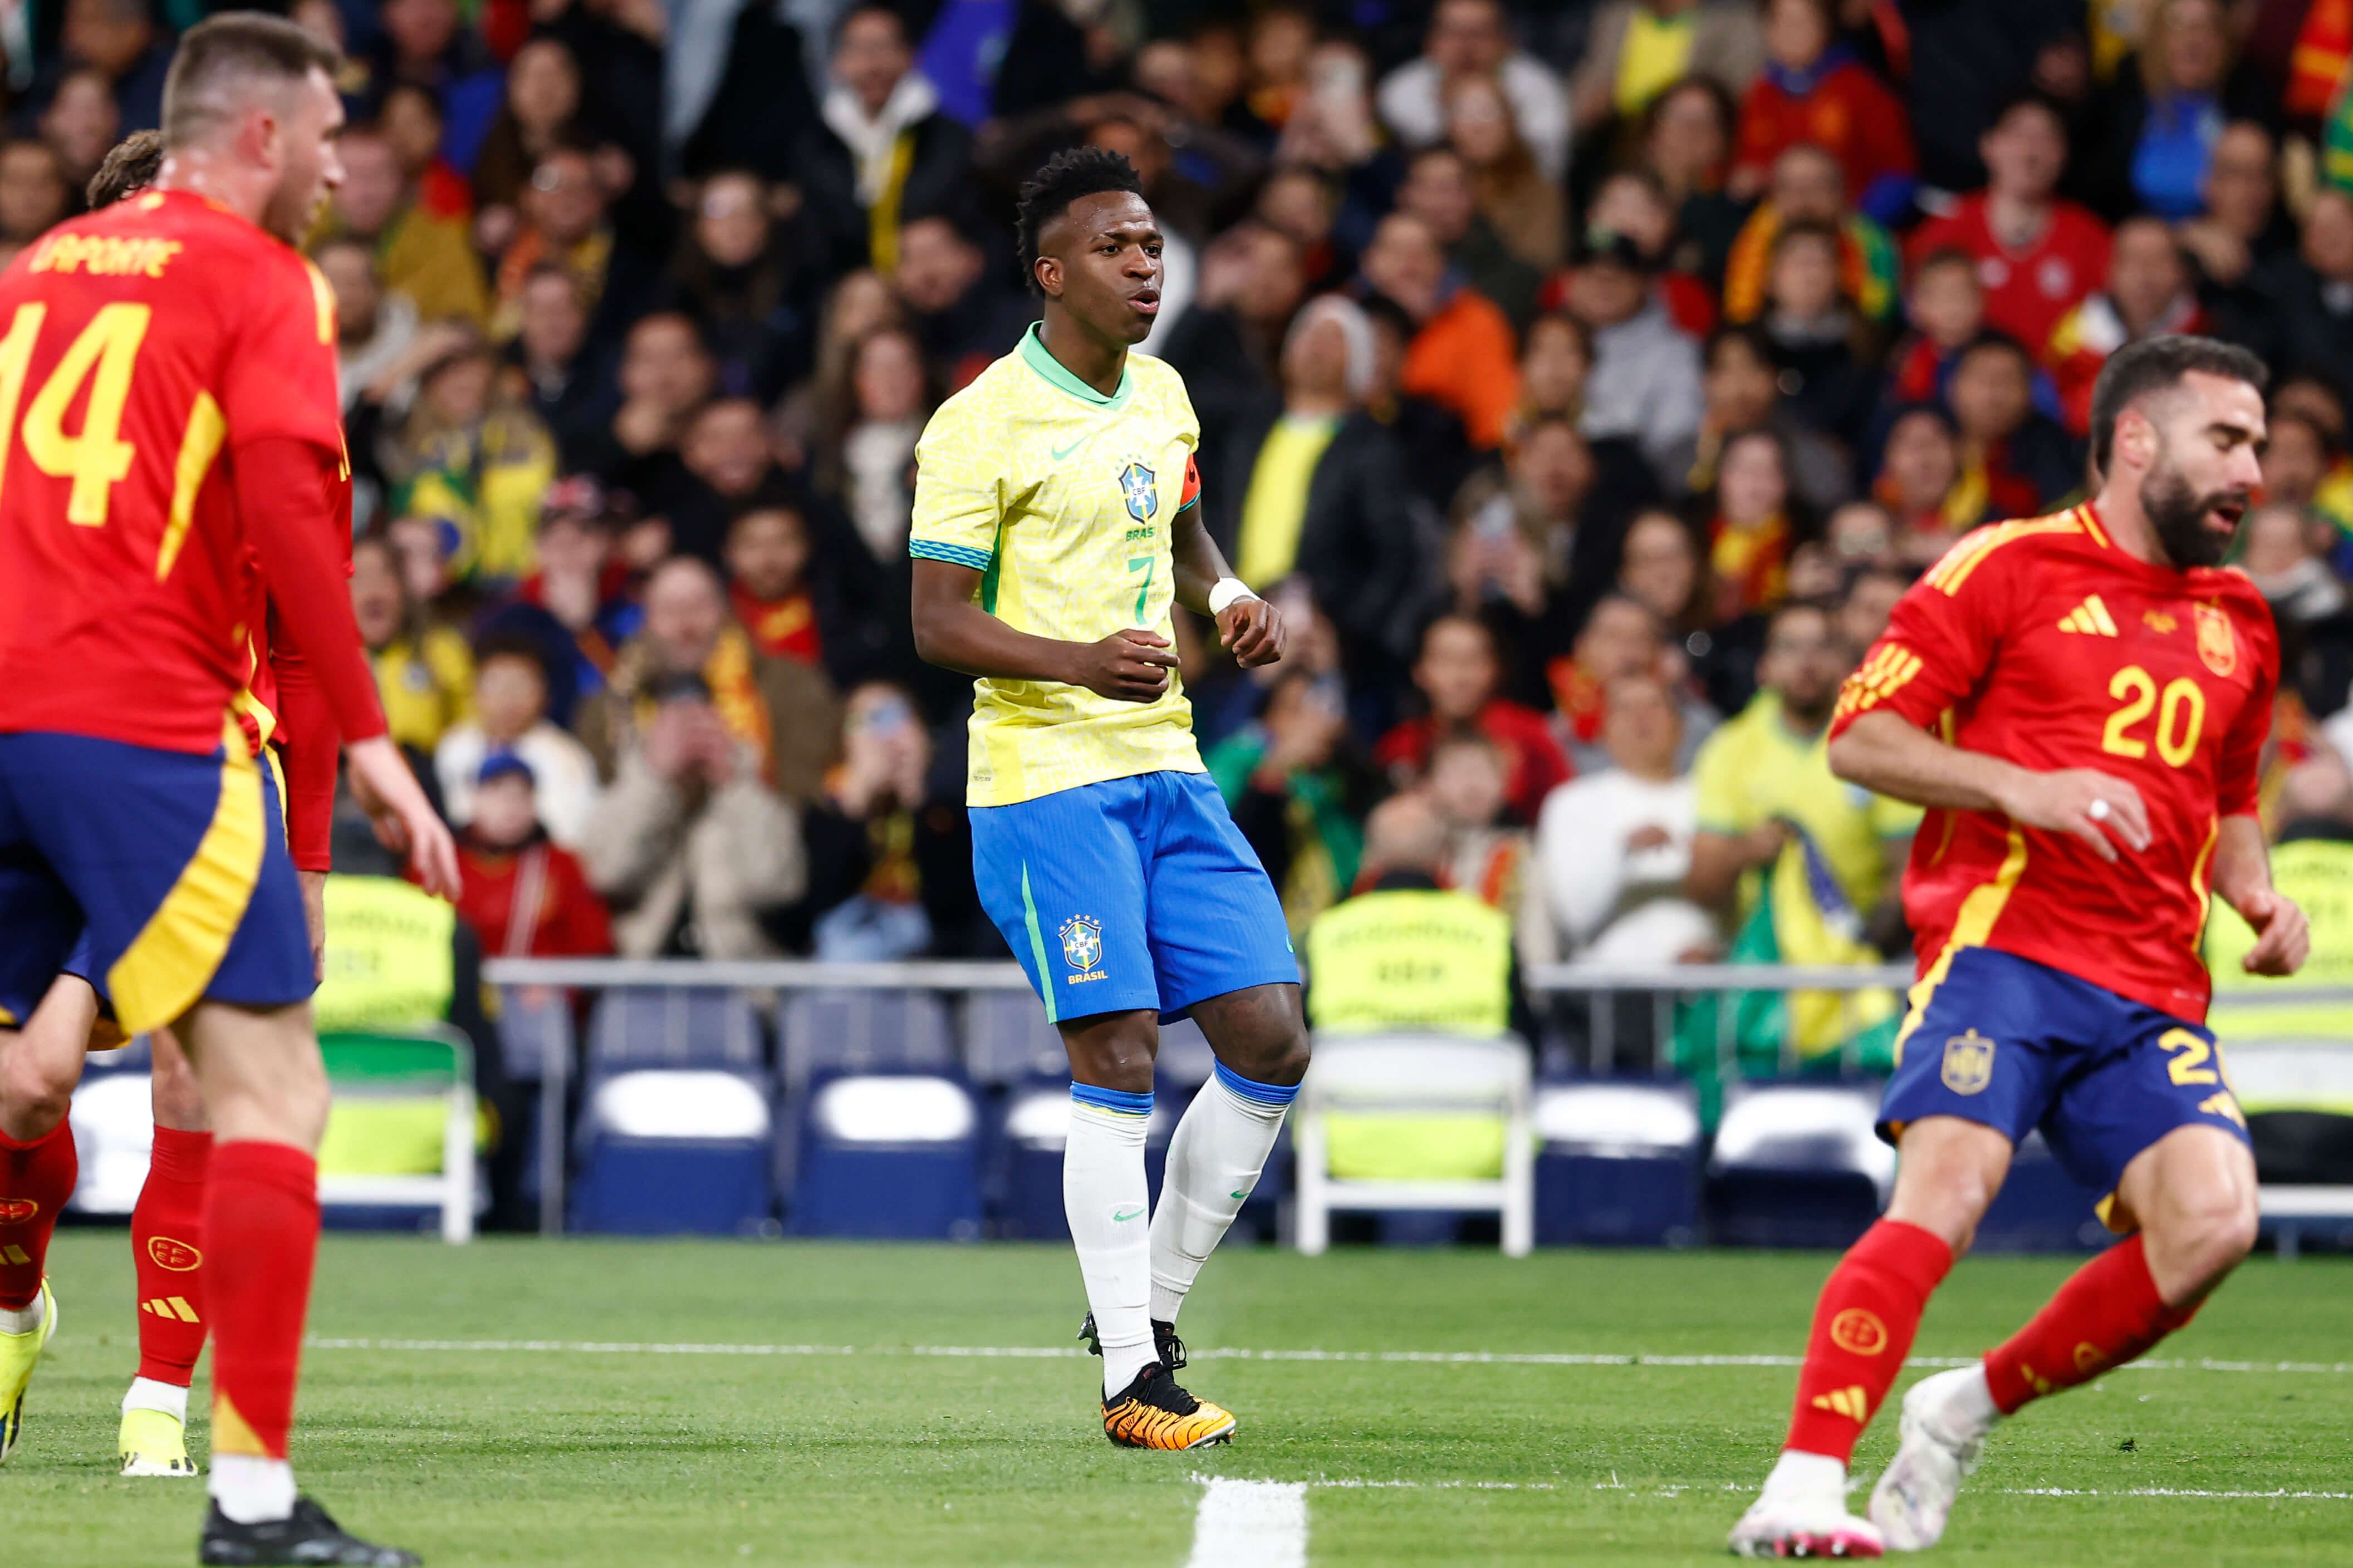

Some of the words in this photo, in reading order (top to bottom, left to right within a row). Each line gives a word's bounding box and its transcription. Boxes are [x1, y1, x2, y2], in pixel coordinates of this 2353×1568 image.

[0, 300, 151, 527] 14
[1133, 486, 1145, 495] CBF
[1128, 556, 1154, 625] 7
[2102, 664, 2206, 768] 20
[1068, 970, 1109, 985] BRASIL
